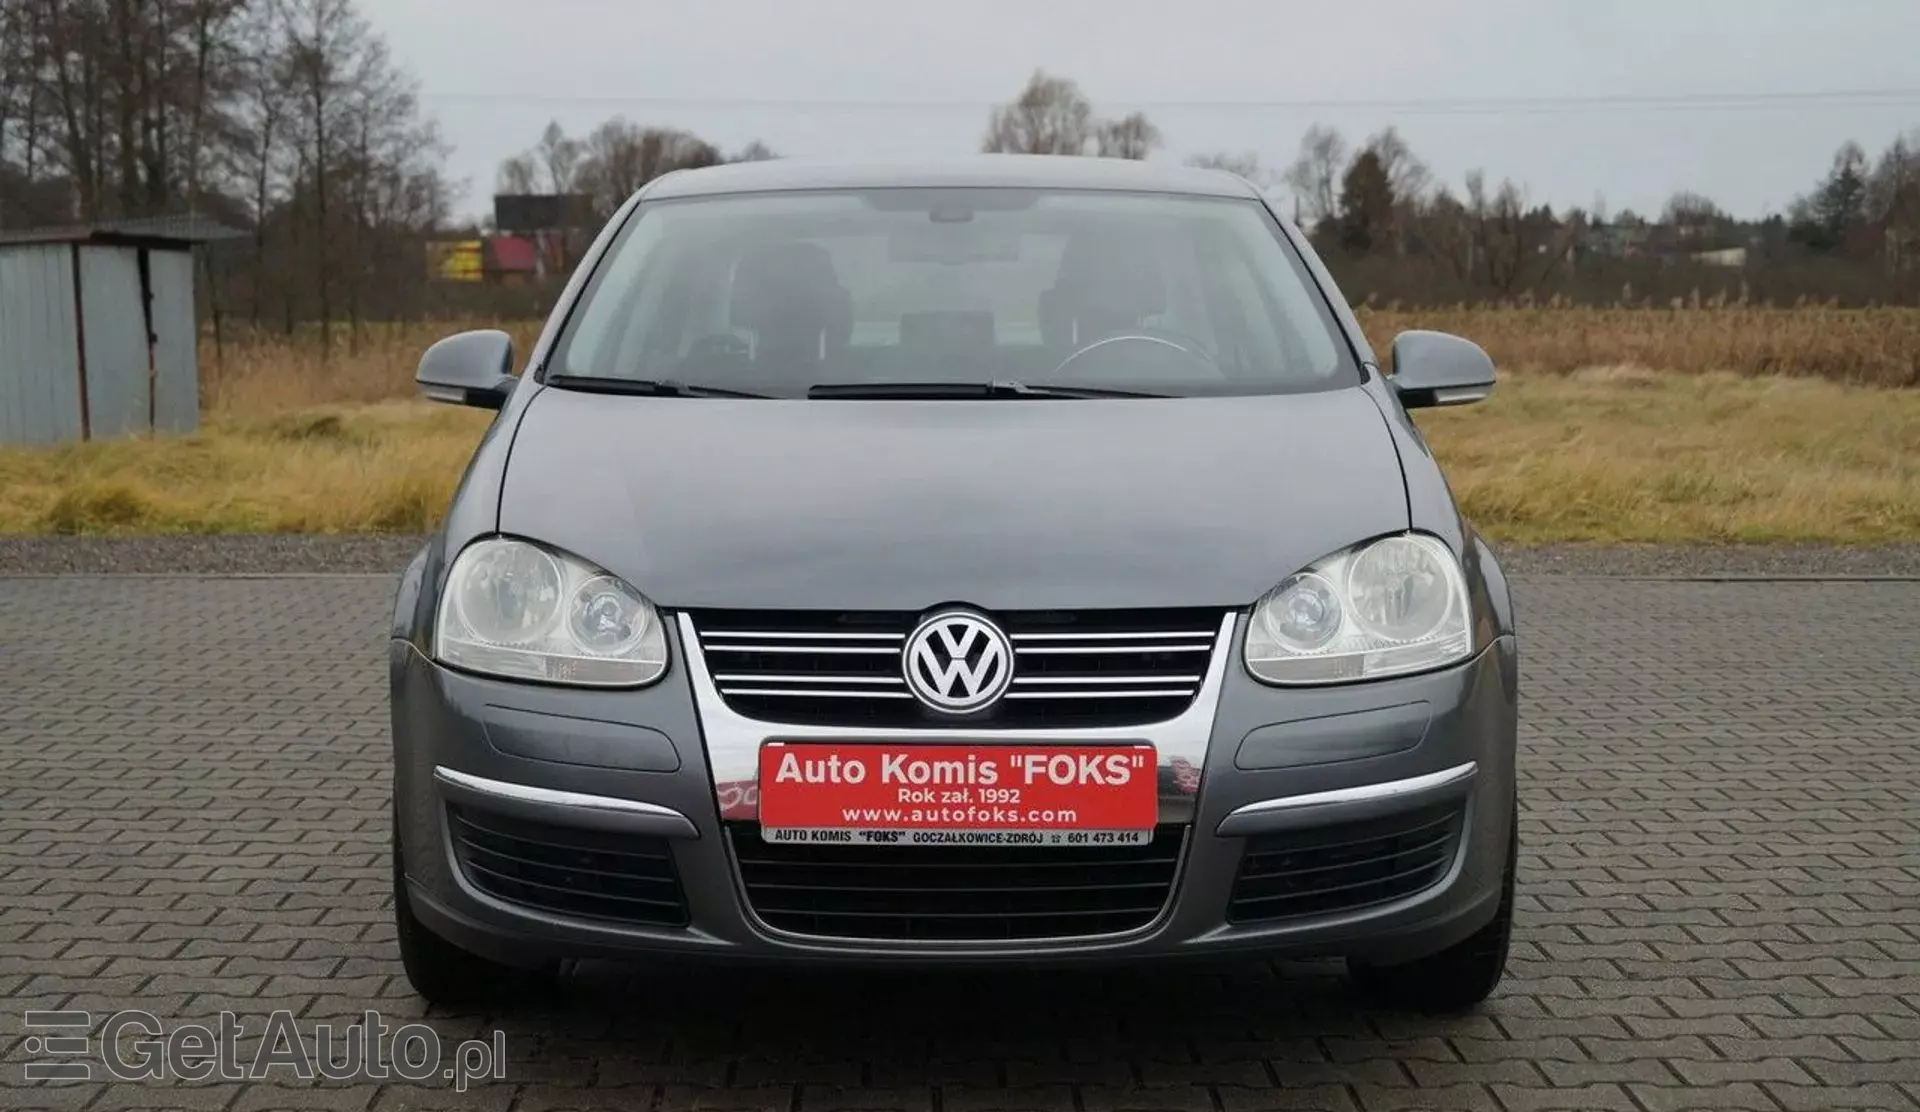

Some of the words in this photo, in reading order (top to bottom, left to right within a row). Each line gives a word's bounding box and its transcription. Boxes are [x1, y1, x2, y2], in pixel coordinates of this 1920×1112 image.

[775, 753, 866, 784] Auto
[881, 753, 999, 785] Komis
[1010, 754, 1145, 785] "FOKS"
[898, 788, 936, 803] Rok
[941, 788, 973, 804] zał.
[979, 788, 1021, 804] 1992
[842, 806, 1077, 823] www.autofoks.com
[774, 829, 808, 842] AUTO
[811, 830, 852, 842] KOMIS
[1067, 832, 1088, 844] 601
[1092, 832, 1115, 844] 473
[1117, 832, 1139, 843] 414
